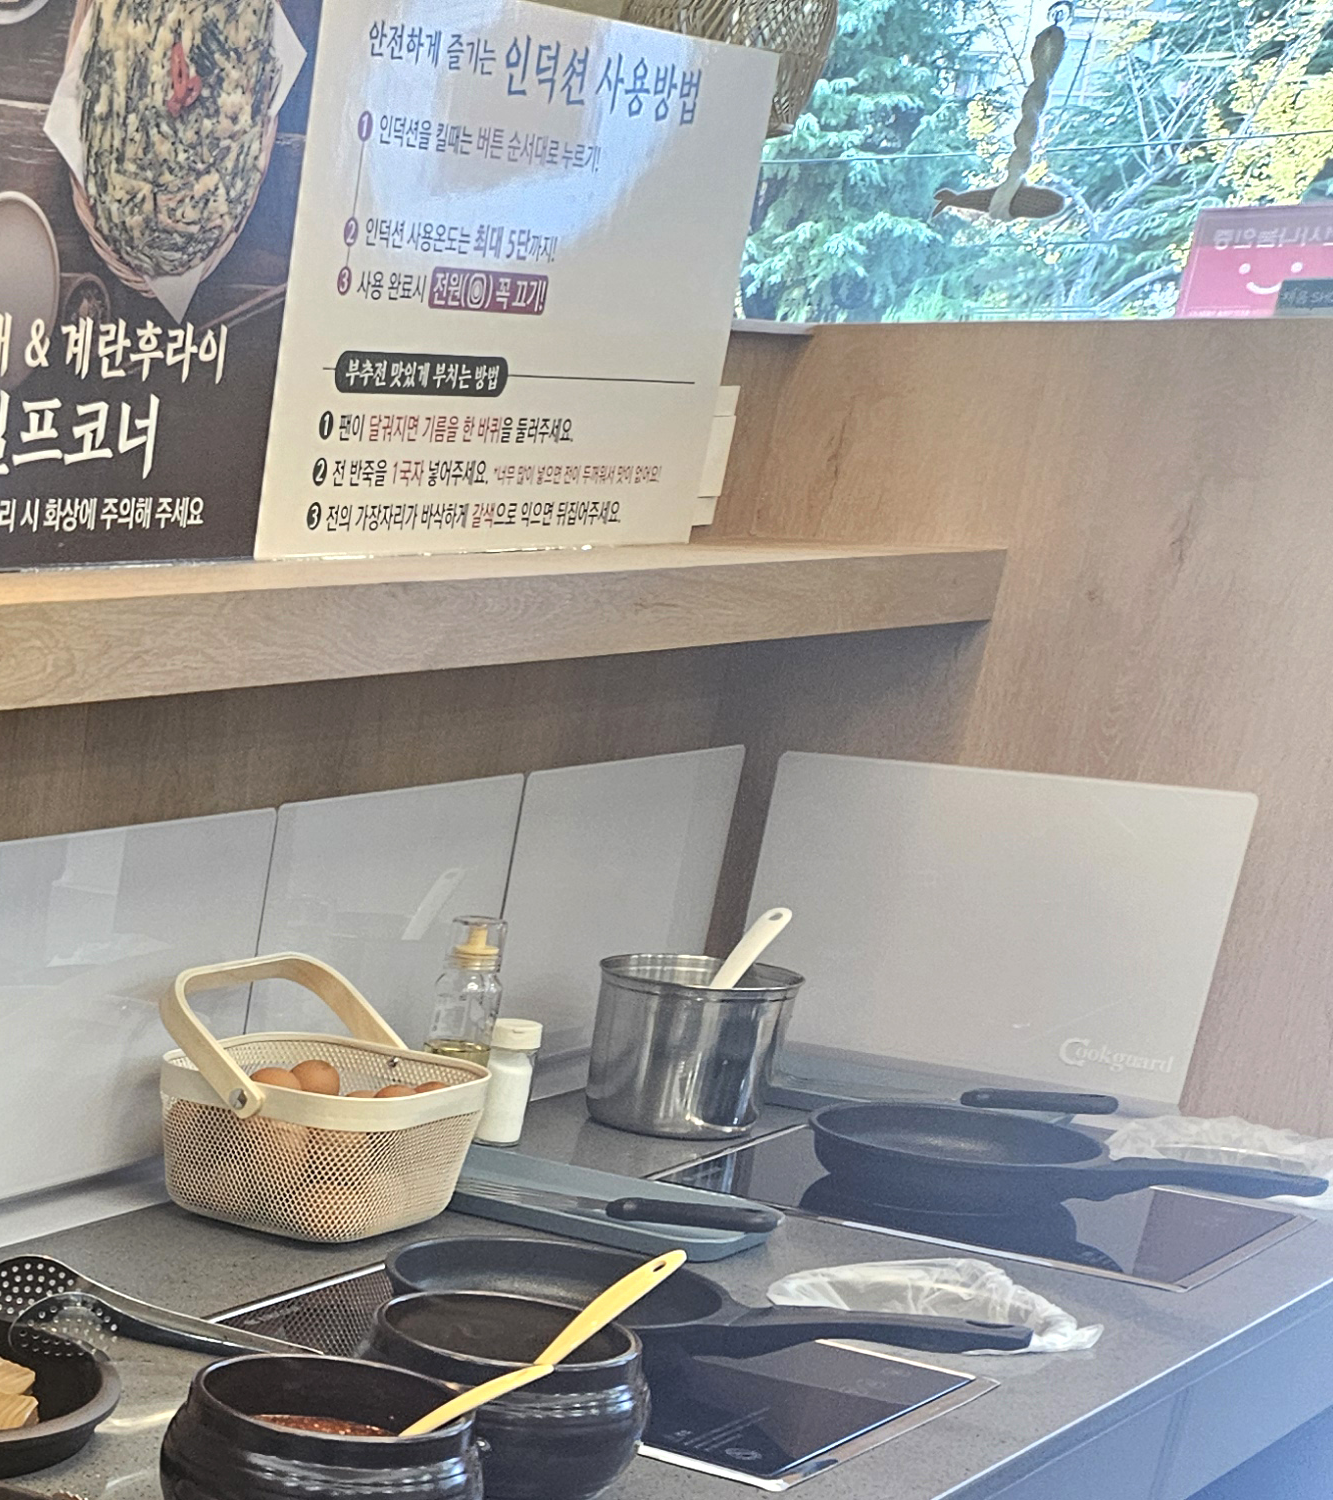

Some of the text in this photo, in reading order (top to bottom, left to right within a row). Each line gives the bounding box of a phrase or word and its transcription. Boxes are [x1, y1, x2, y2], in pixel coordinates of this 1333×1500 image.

[369, 20, 702, 126] 안전하게 즐기는 인덕션 사용방법
[379, 114, 432, 151] 인덕션을
[477, 126, 505, 159] 버튼
[507, 131, 559, 166] 순서대로
[560, 142, 602, 173] 누르기!
[365, 217, 405, 250] 인덕션
[406, 220, 471, 254] 사용온도는
[473, 223, 504, 258] 최대
[356, 270, 383, 300] 사용
[387, 272, 427, 303] 완료시
[496, 277, 511, 310] 꼭
[25, 318, 50, 368] &
[61, 315, 228, 384] 계란후라이
[345, 359, 500, 390] 부추전 맛있게 부치는 방법
[339, 414, 365, 442] 팬이
[369, 415, 420, 442] 달궈지면
[422, 415, 459, 443] 기름을
[463, 416, 475, 443] 한
[515, 417, 574, 443] 둘러주세요.
[333, 459, 346, 487] 전
[350, 460, 387, 486] 반죽을
[392, 460, 424, 486] 1국자
[21, 498, 39, 531] 시
[43, 497, 97, 532] 화상에
[100, 497, 153, 532] 주의해
[155, 497, 205, 529] 주세요
[326, 504, 353, 532] 전의
[355, 503, 418, 530] 가장자리가
[420, 502, 468, 530] 바삭하게
[471, 502, 518, 529] 갈색으로
[520, 502, 554, 527] 익으면
[1059, 1037, 1174, 1073] Cookguard
